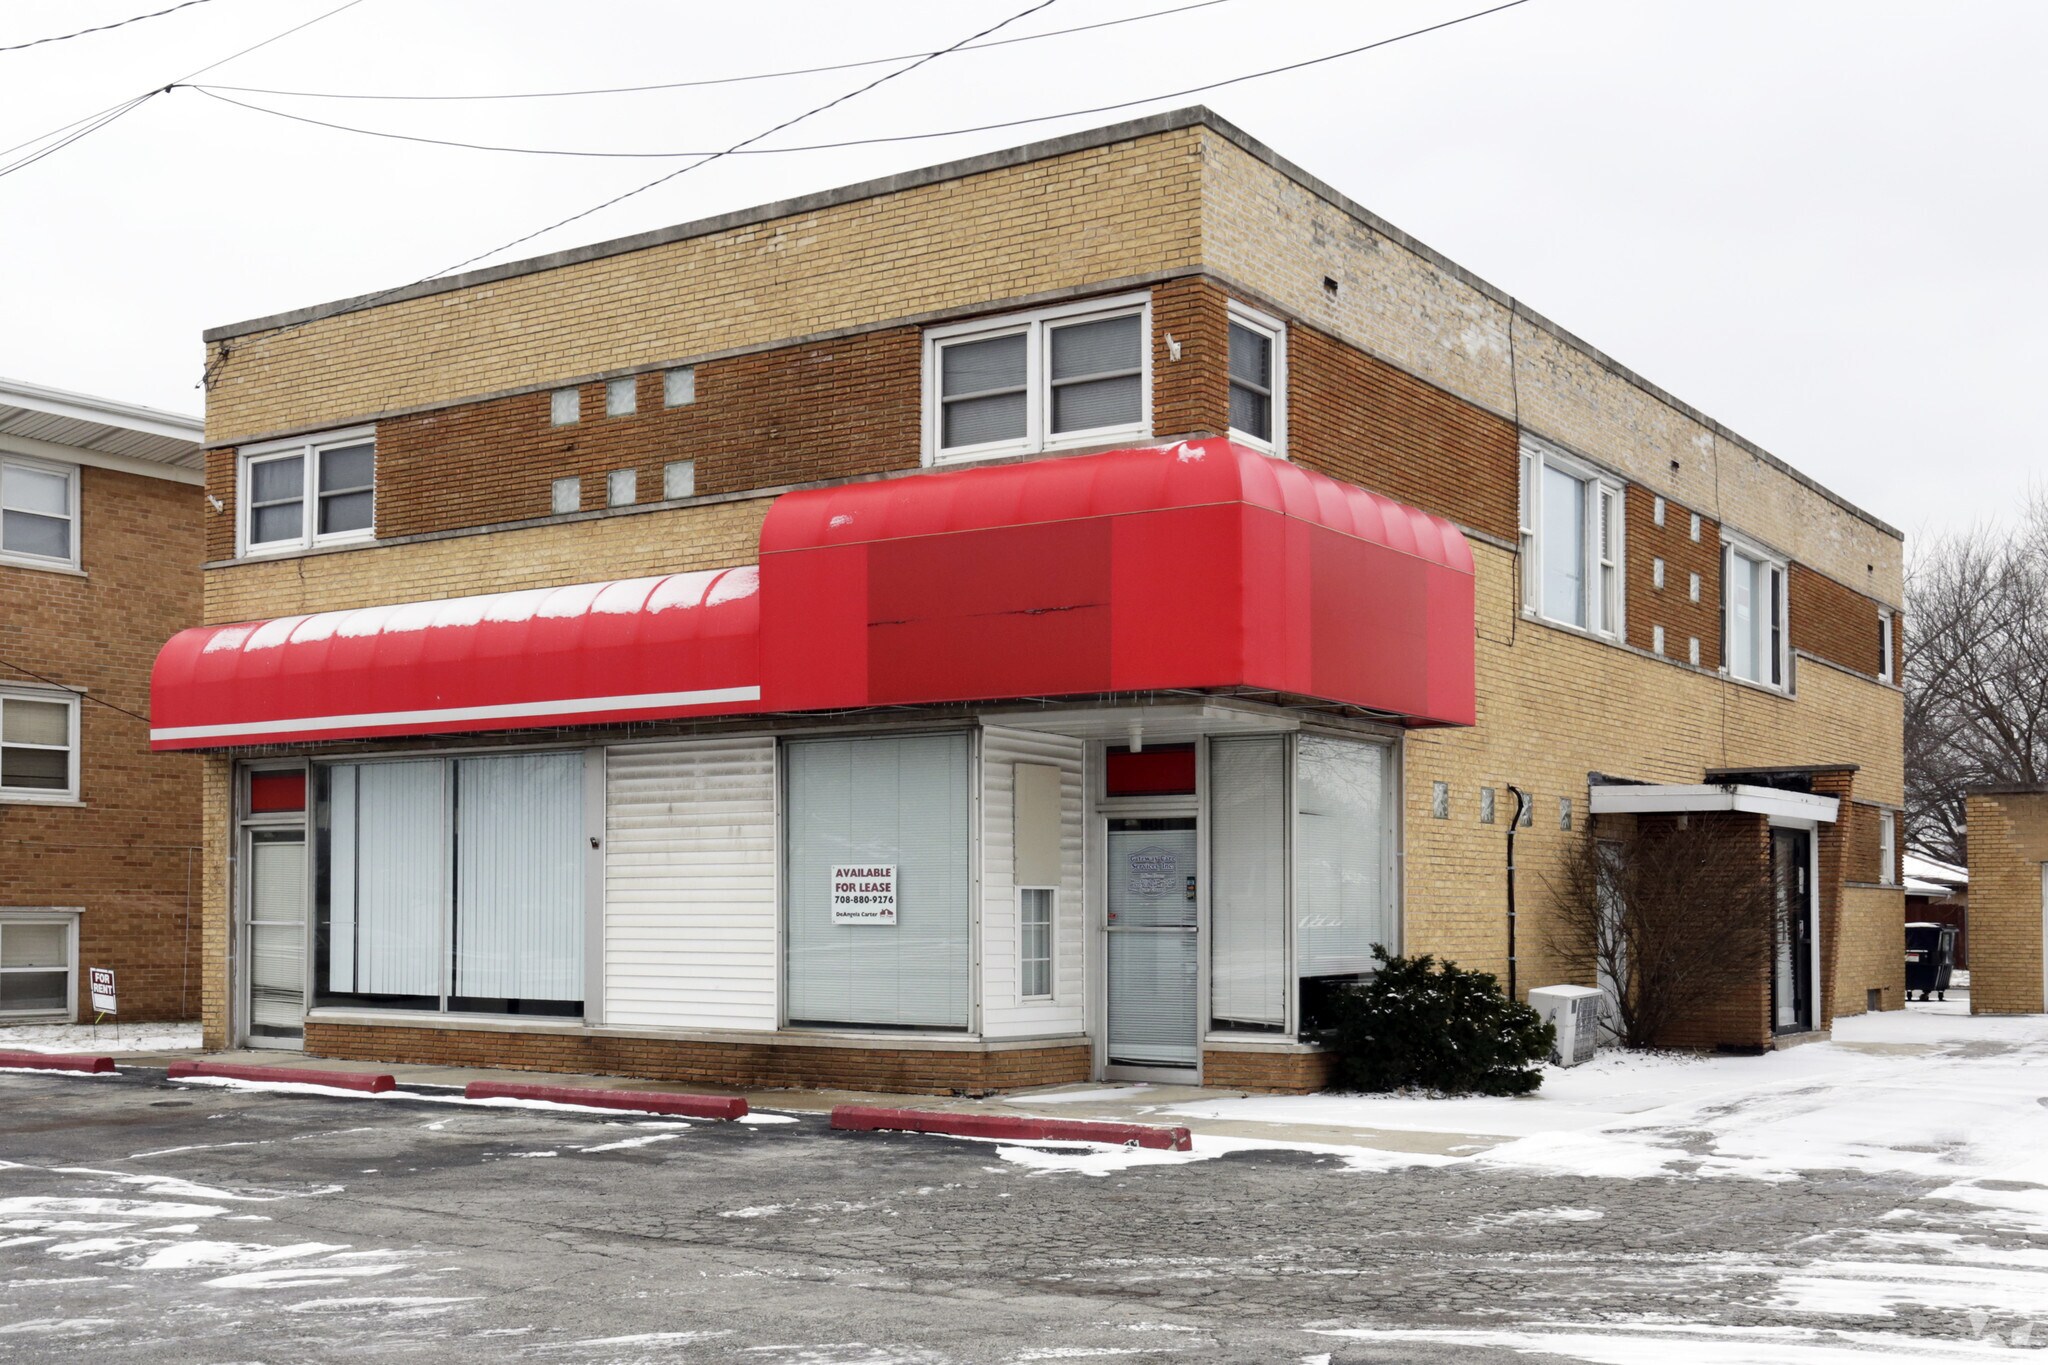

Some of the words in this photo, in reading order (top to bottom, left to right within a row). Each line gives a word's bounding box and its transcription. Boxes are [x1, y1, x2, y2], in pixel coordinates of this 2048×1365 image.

[836, 868, 891, 877] AVAILABLE
[836, 883, 856, 892] FOR
[860, 883, 891, 892] LEASE
[95, 973, 110, 984] FOR
[94, 983, 112, 995] RENT
